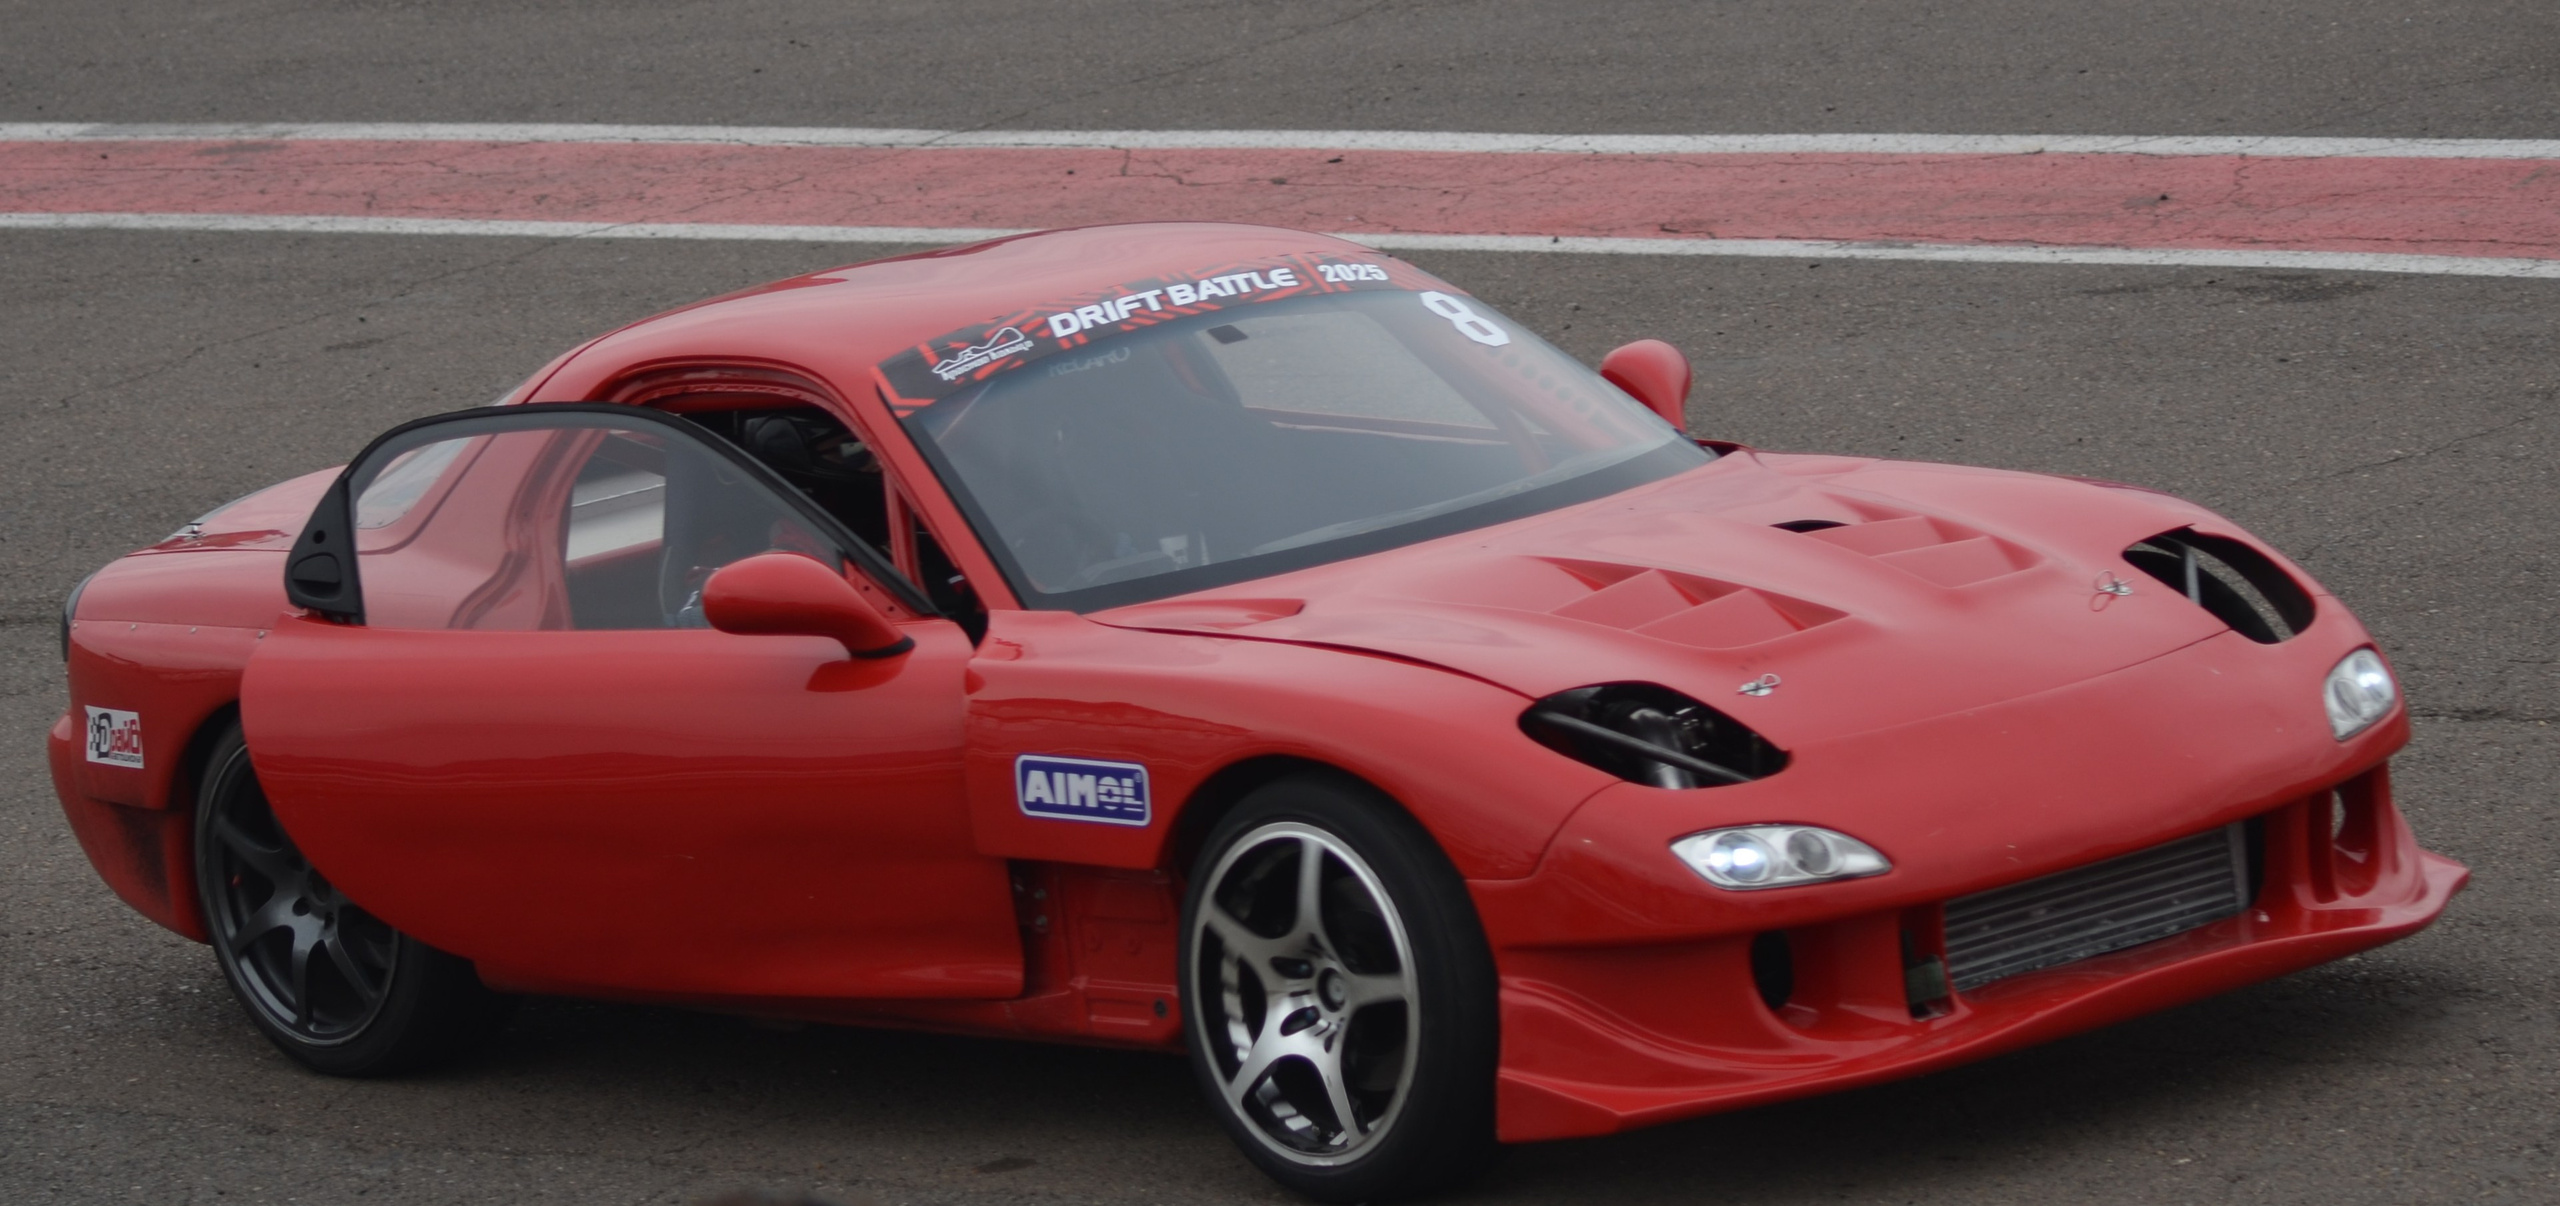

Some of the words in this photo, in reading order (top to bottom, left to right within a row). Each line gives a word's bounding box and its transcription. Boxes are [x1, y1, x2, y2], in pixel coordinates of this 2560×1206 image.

[1048, 289, 1162, 338] DRIFT
[1166, 267, 1299, 306] BATTLE
[1317, 263, 1389, 283] 2025
[1418, 290, 1511, 347] 8
[1024, 769, 1144, 812] AIMOL
